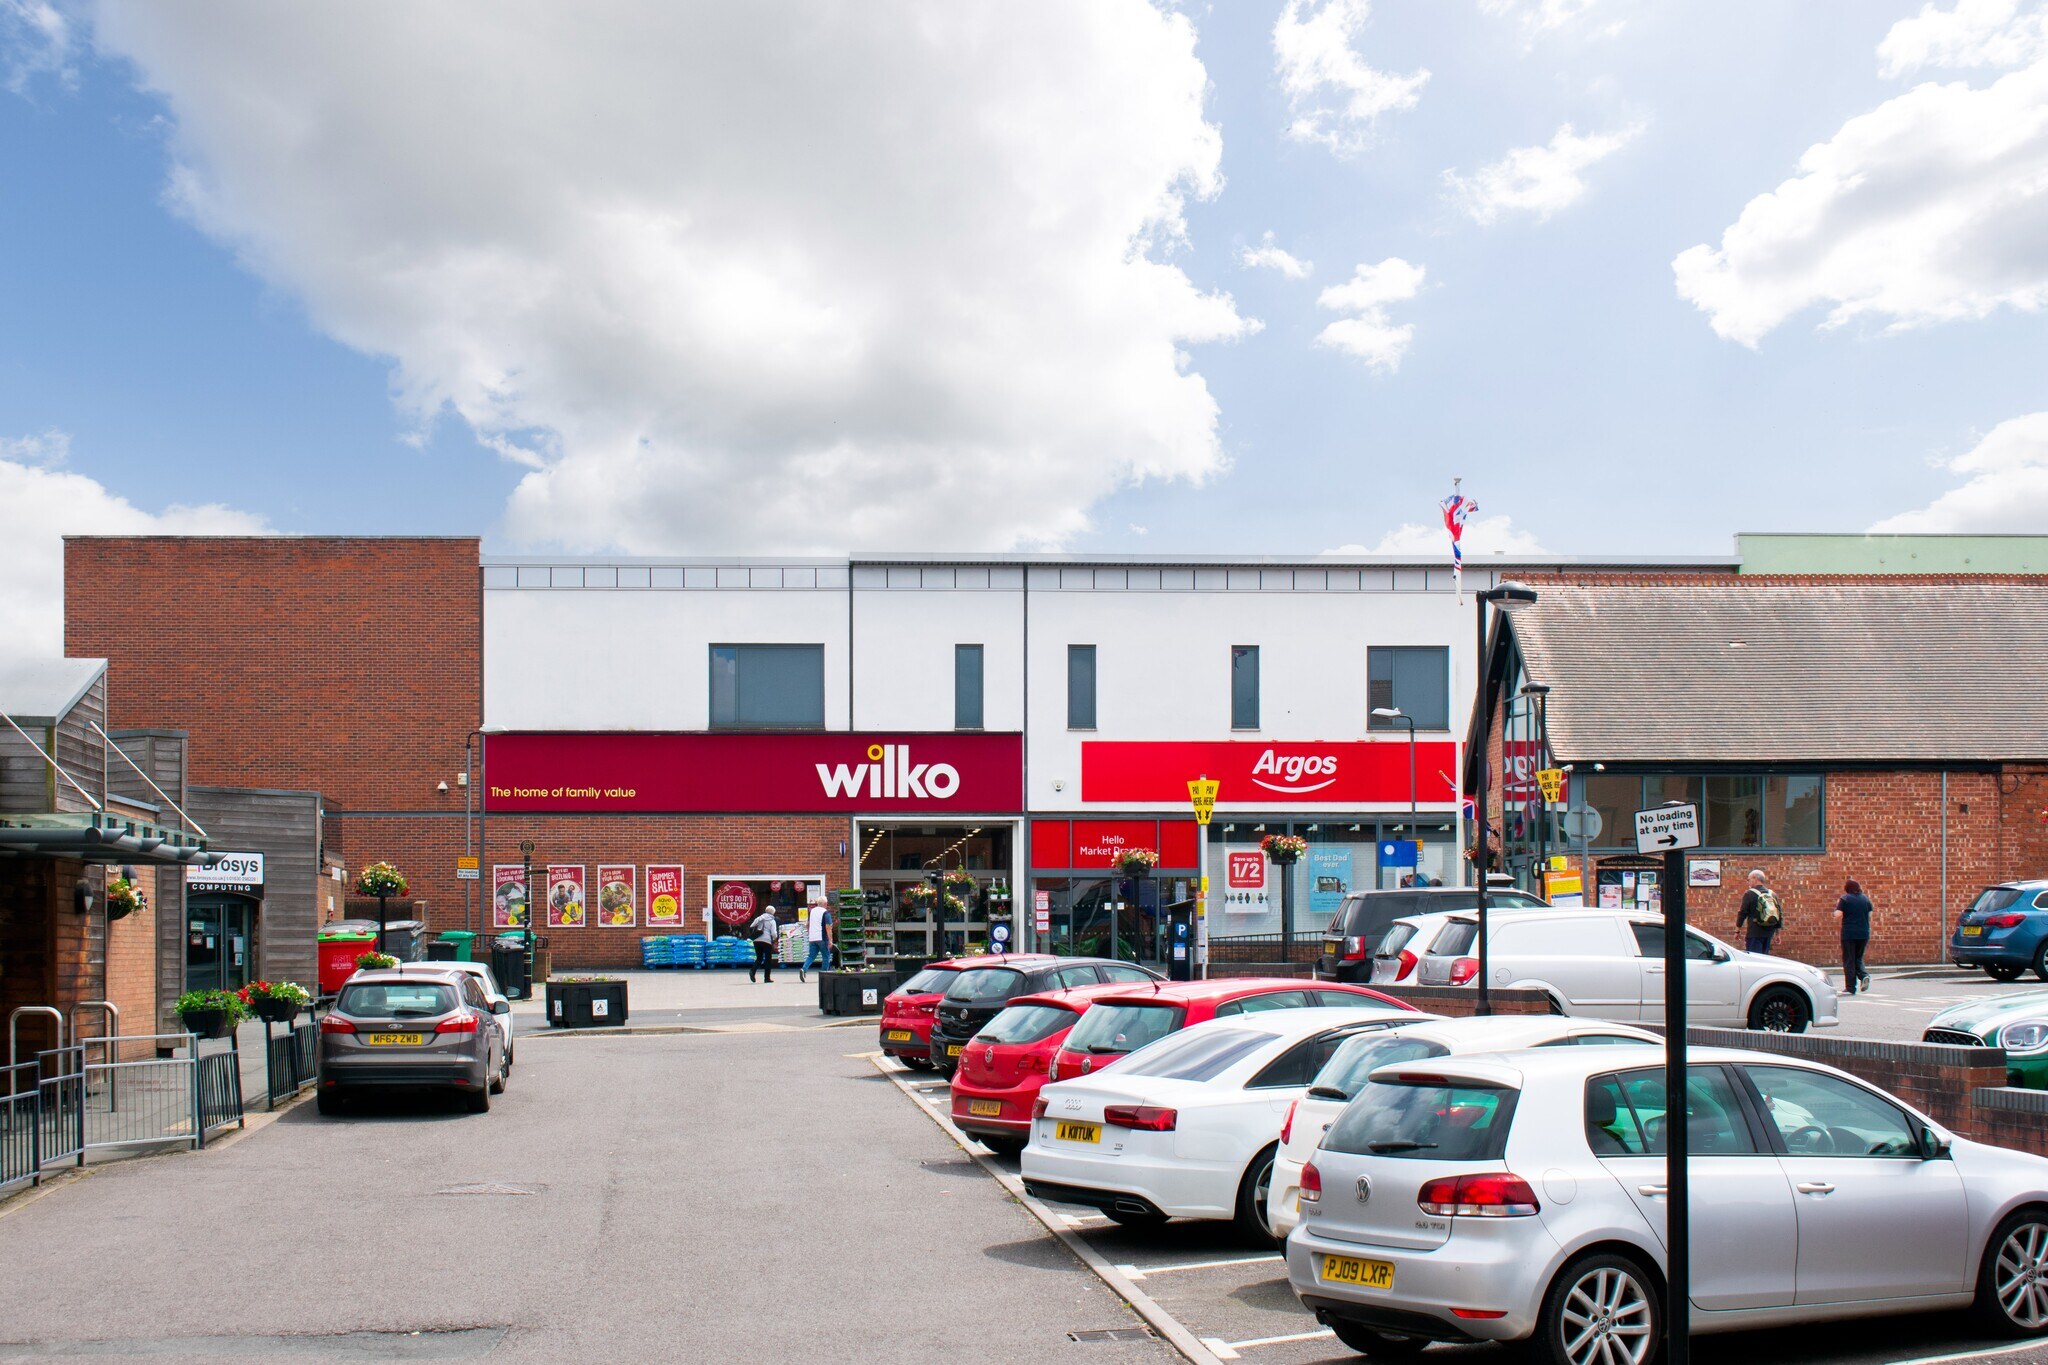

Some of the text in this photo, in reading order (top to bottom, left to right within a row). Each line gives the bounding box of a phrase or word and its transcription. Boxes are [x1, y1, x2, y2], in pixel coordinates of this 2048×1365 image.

[815, 744, 960, 799] wilko
[1252, 749, 1338, 782] Argos
[490, 786, 637, 800] The home of family value
[1206, 785, 1215, 795] PAY
[1203, 796, 1215, 806] HERE
[1640, 810, 1692, 824] No loading
[1639, 821, 1694, 835] at any time
[1101, 835, 1125, 845] Hello
[1080, 846, 1112, 856] Market
[1232, 862, 1261, 878] 1/2
[652, 871, 675, 882] SUMMER
[191, 883, 252, 892] COMPUTING
[651, 879, 678, 894] SALE!
[720, 901, 749, 910] TOGETHER!
[1178, 924, 1187, 936] P
[372, 1033, 419, 1044] MF62 ZWB
[1060, 1125, 1066, 1138] A
[1327, 1259, 1389, 1285] PJ09 LXR
